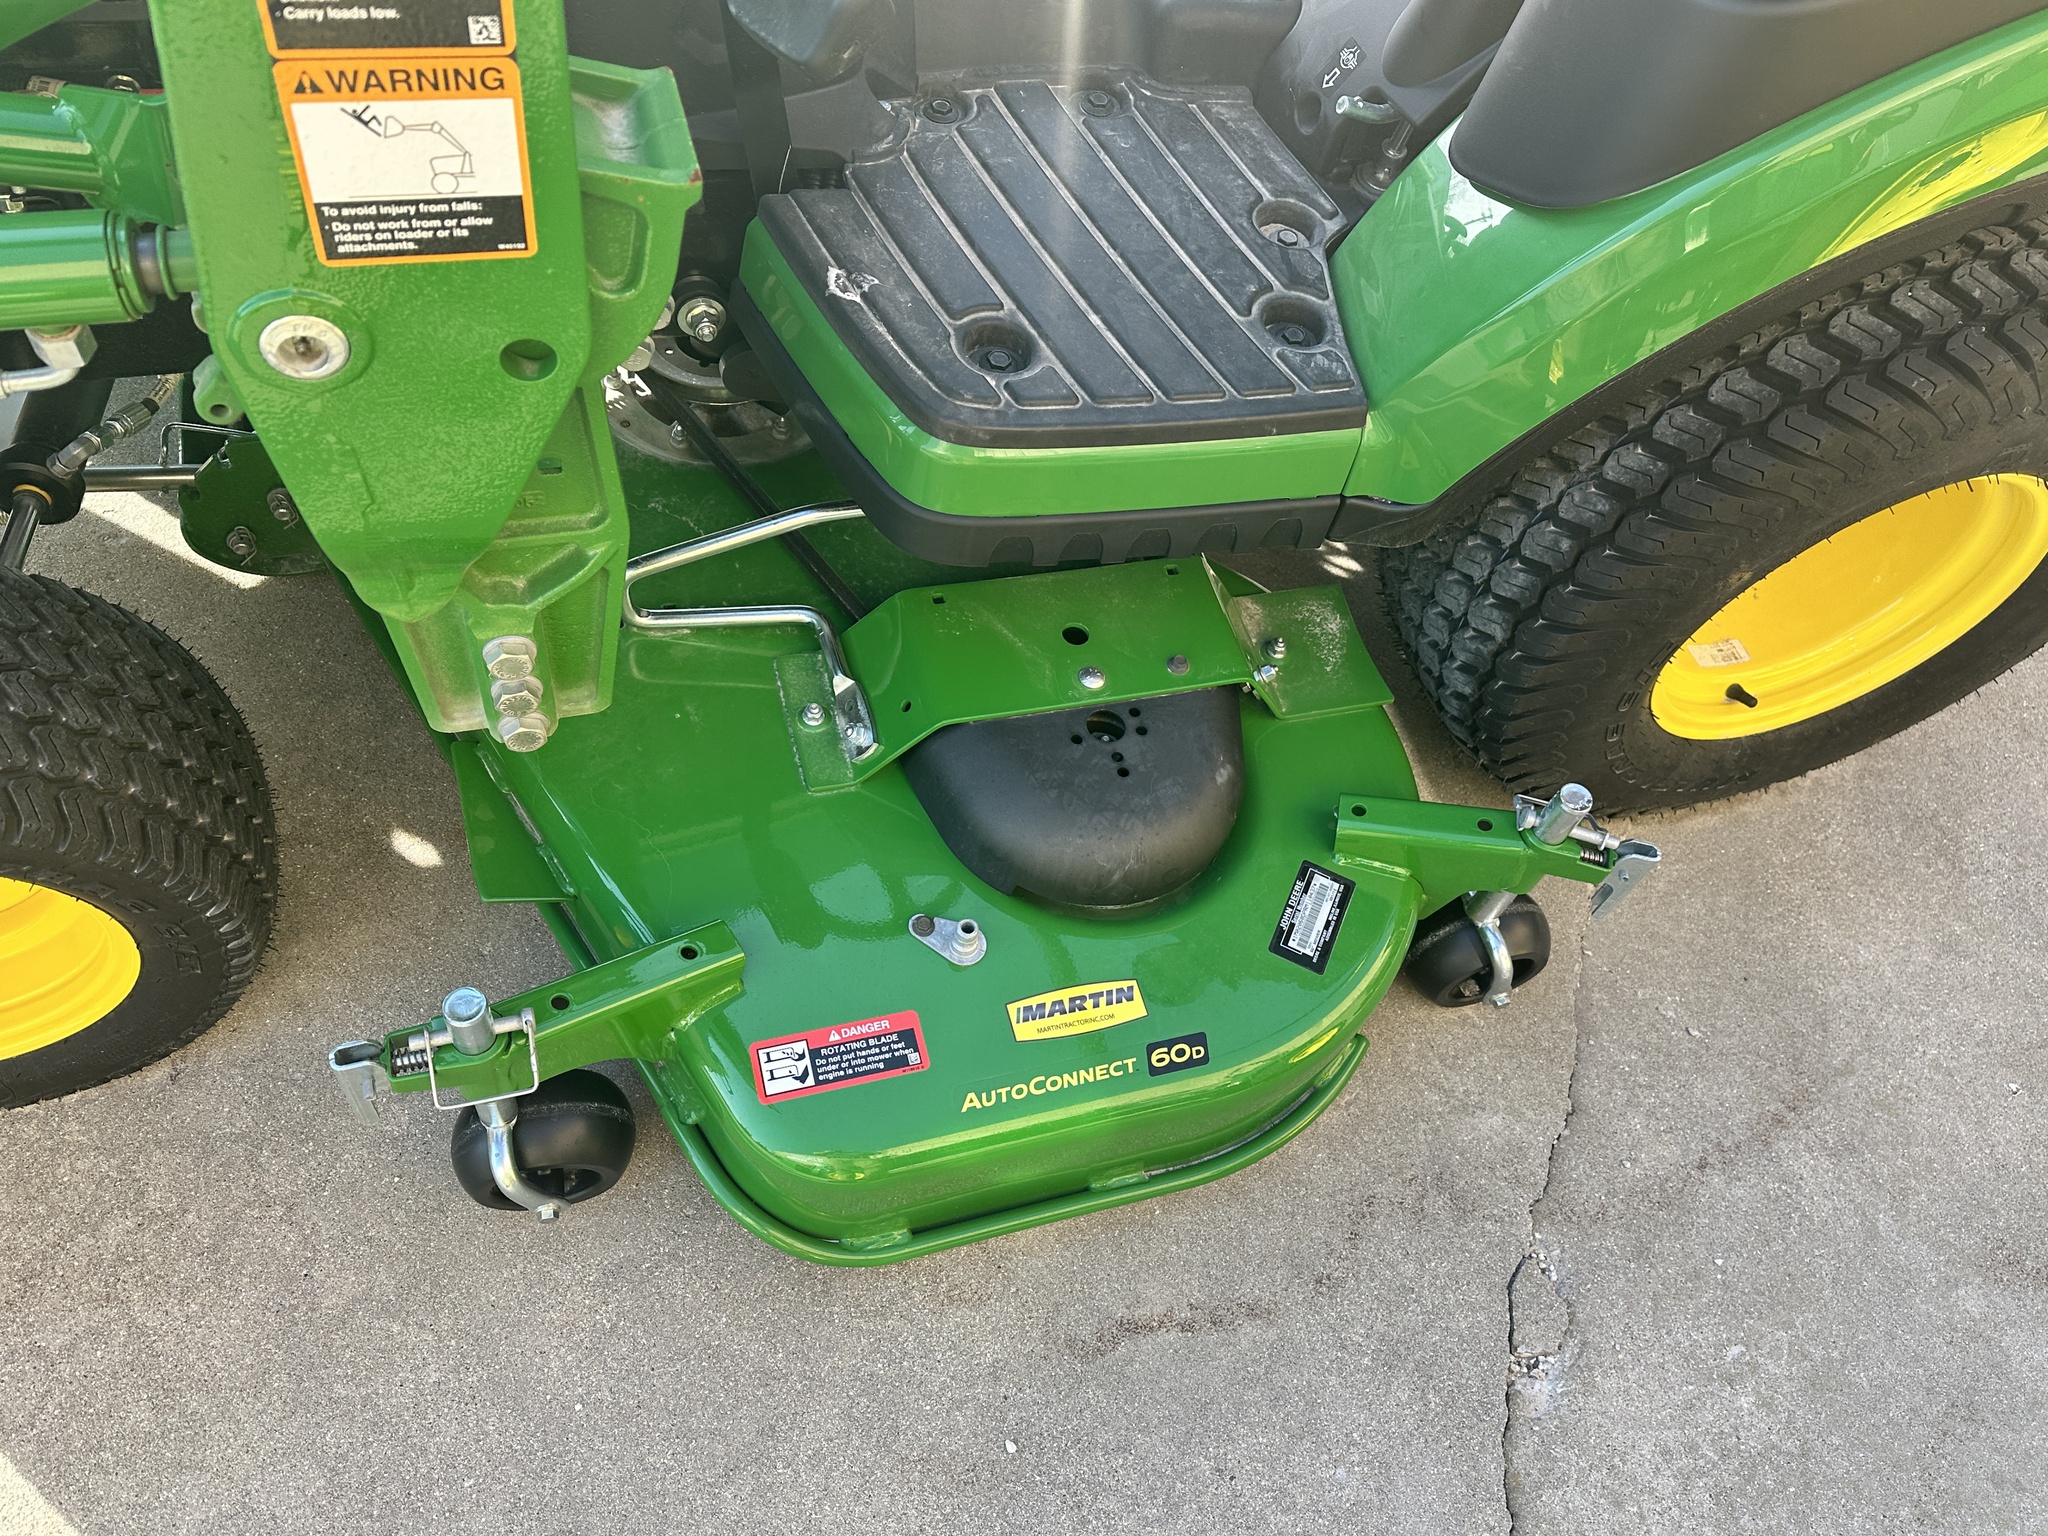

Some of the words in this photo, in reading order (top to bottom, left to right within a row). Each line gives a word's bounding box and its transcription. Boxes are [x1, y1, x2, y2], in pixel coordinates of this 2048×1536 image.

[283, 6, 324, 22] Carry
[326, 5, 368, 20] loads
[369, 5, 401, 20] low.
[325, 67, 505, 93] WARNING
[321, 206, 339, 216] To
[341, 204, 377, 216] avoid
[379, 203, 416, 216] injury
[419, 203, 449, 213] from
[451, 201, 483, 212] falls:
[332, 222, 351, 232] Do
[353, 221, 375, 231] not
[378, 219, 409, 229] work
[411, 218, 441, 228] from
[444, 218, 457, 227] or
[460, 216, 493, 226] allow
[334, 231, 372, 242] riders
[375, 232, 392, 241] on
[394, 229, 434, 240] loader
[436, 229, 450, 237] or
[452, 227, 470, 237] its
[337, 241, 419, 253] attachments.
[1280, 906, 1293, 931] JOHN
[1288, 879, 1304, 906] DEERE
[1021, 985, 1134, 1023] MARTIN
[841, 1020, 890, 1038] DANGER
[1037, 1013, 1115, 1035] MARTINTRACTORINC.COM
[815, 1058, 827, 1066] Do
[828, 1055, 841, 1064] not
[842, 1052, 855, 1063] put
[856, 1047, 880, 1058] hands
[890, 1041, 906, 1050] feet
[820, 1040, 867, 1056] ROTATING
[868, 1033, 899, 1047] BLADE
[1150, 1043, 1205, 1068] 60D
[817, 1063, 839, 1073] under
[850, 1058, 866, 1067] into
[867, 1052, 892, 1062] mower
[894, 1048, 914, 1057] when
[818, 1070, 845, 1081] engine
[845, 1067, 853, 1075] is
[855, 1062, 885, 1073] running
